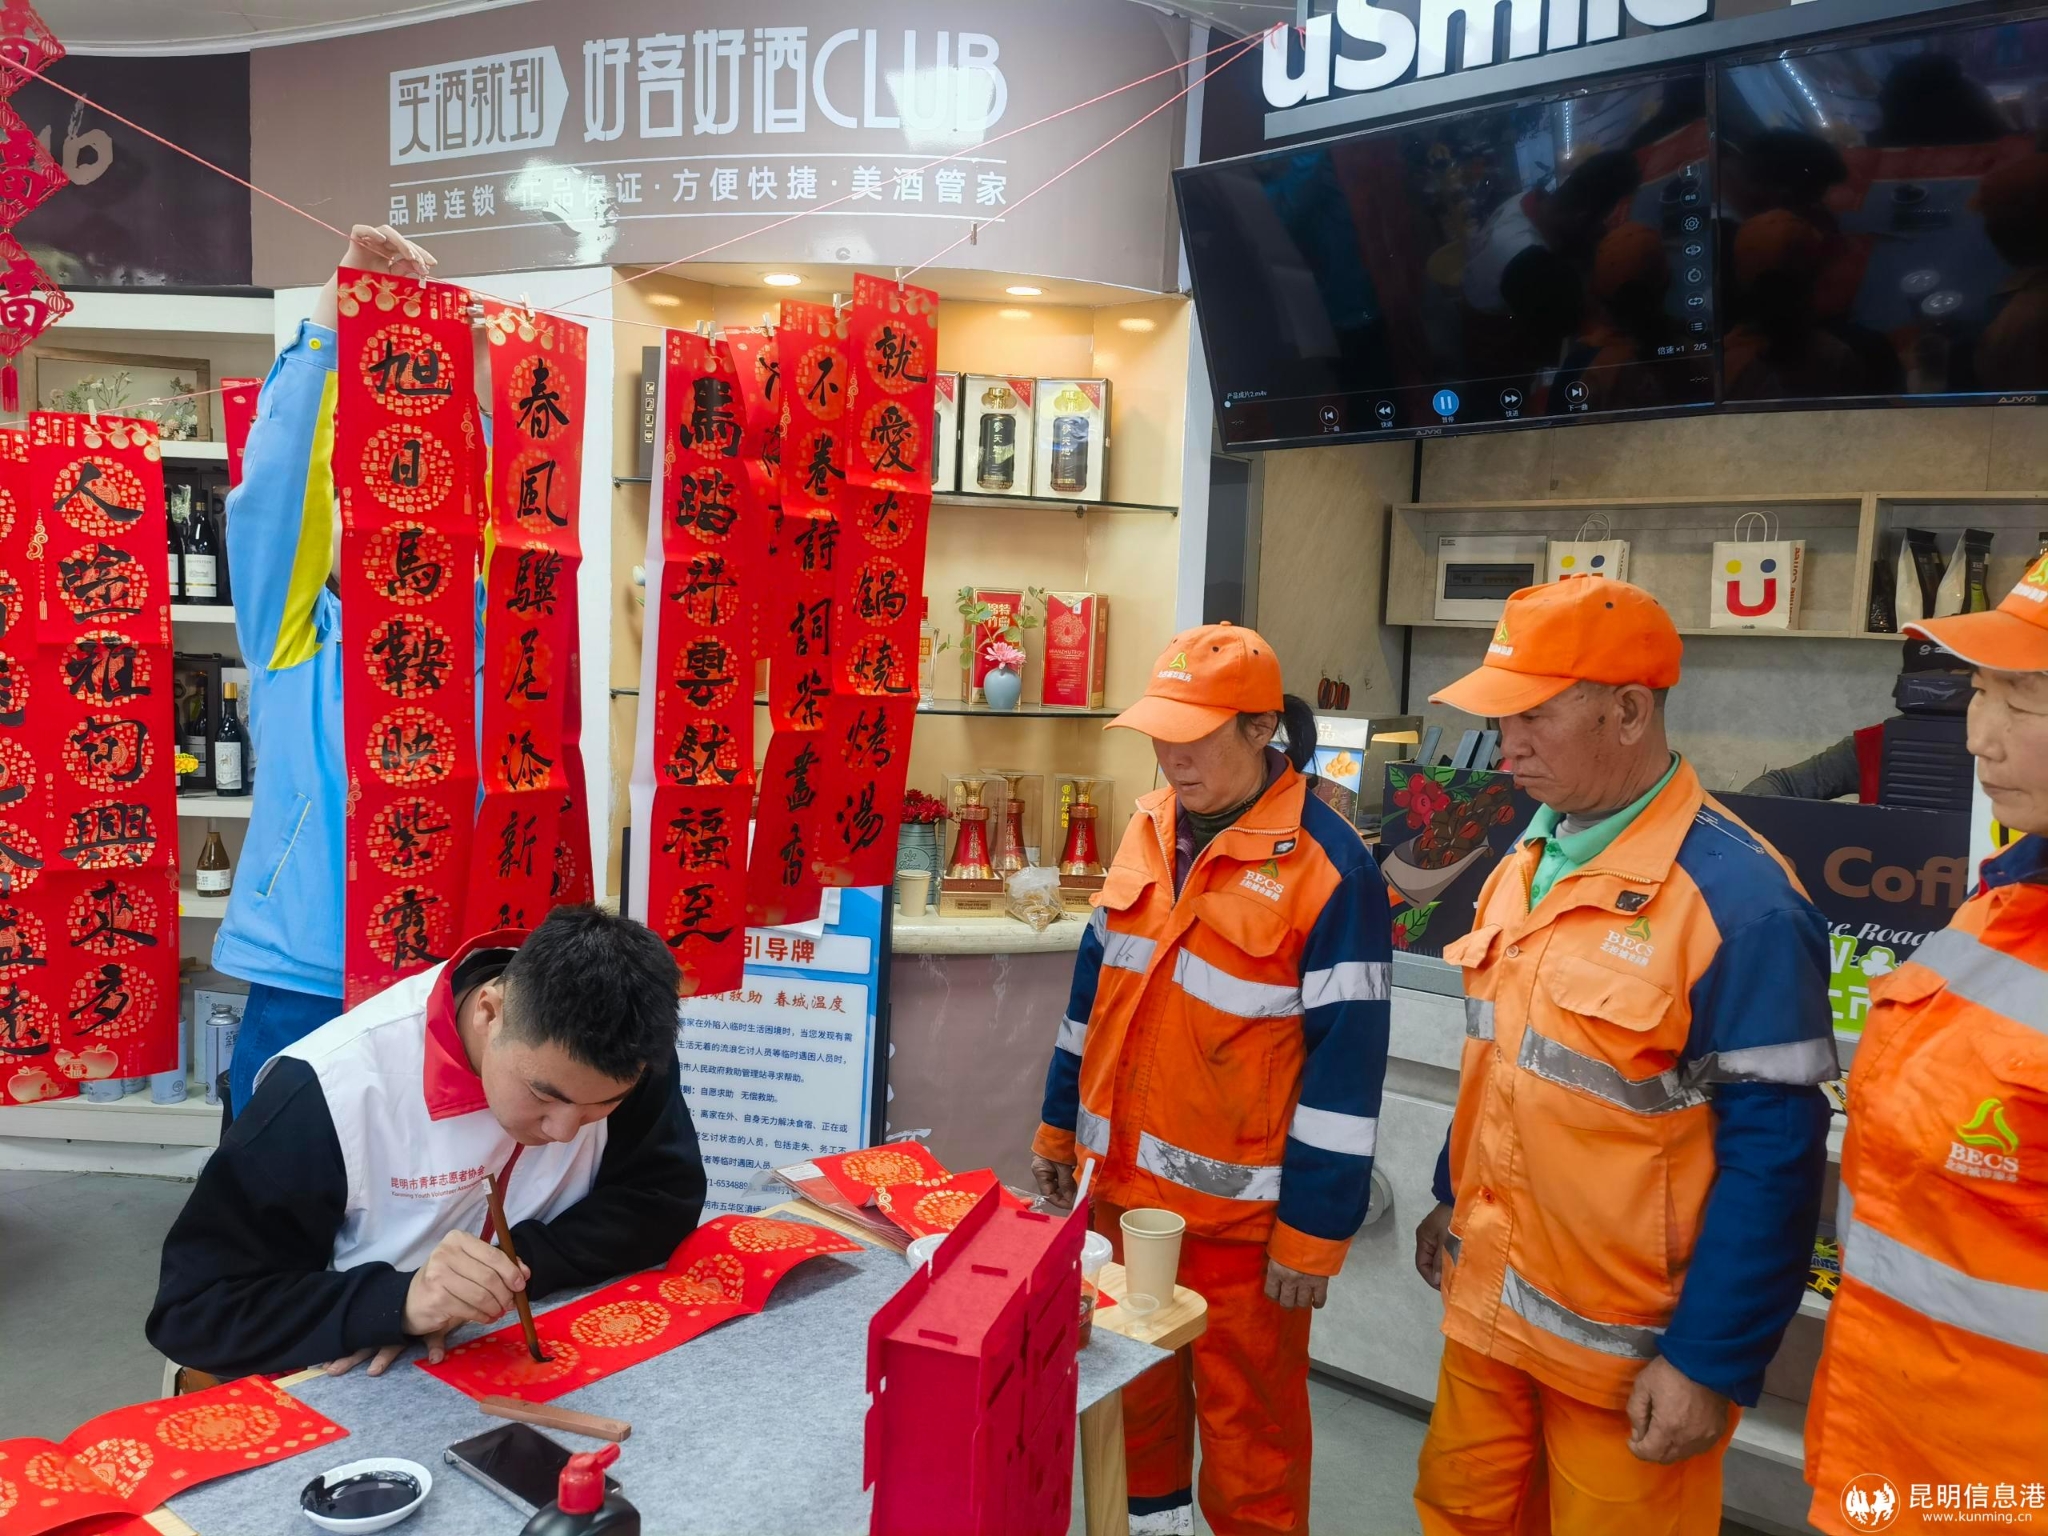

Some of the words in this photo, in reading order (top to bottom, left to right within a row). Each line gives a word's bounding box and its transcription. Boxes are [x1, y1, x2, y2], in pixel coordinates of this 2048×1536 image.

[398, 57, 546, 154] 买酒就到
[1243, 869, 1285, 894] BECS
[1604, 929, 1655, 957] BECS
[773, 990, 846, 1013] 春城温度
[1948, 1141, 2019, 1173] BECS
[391, 1164, 486, 1190] 昆明市青年志愿者协会
